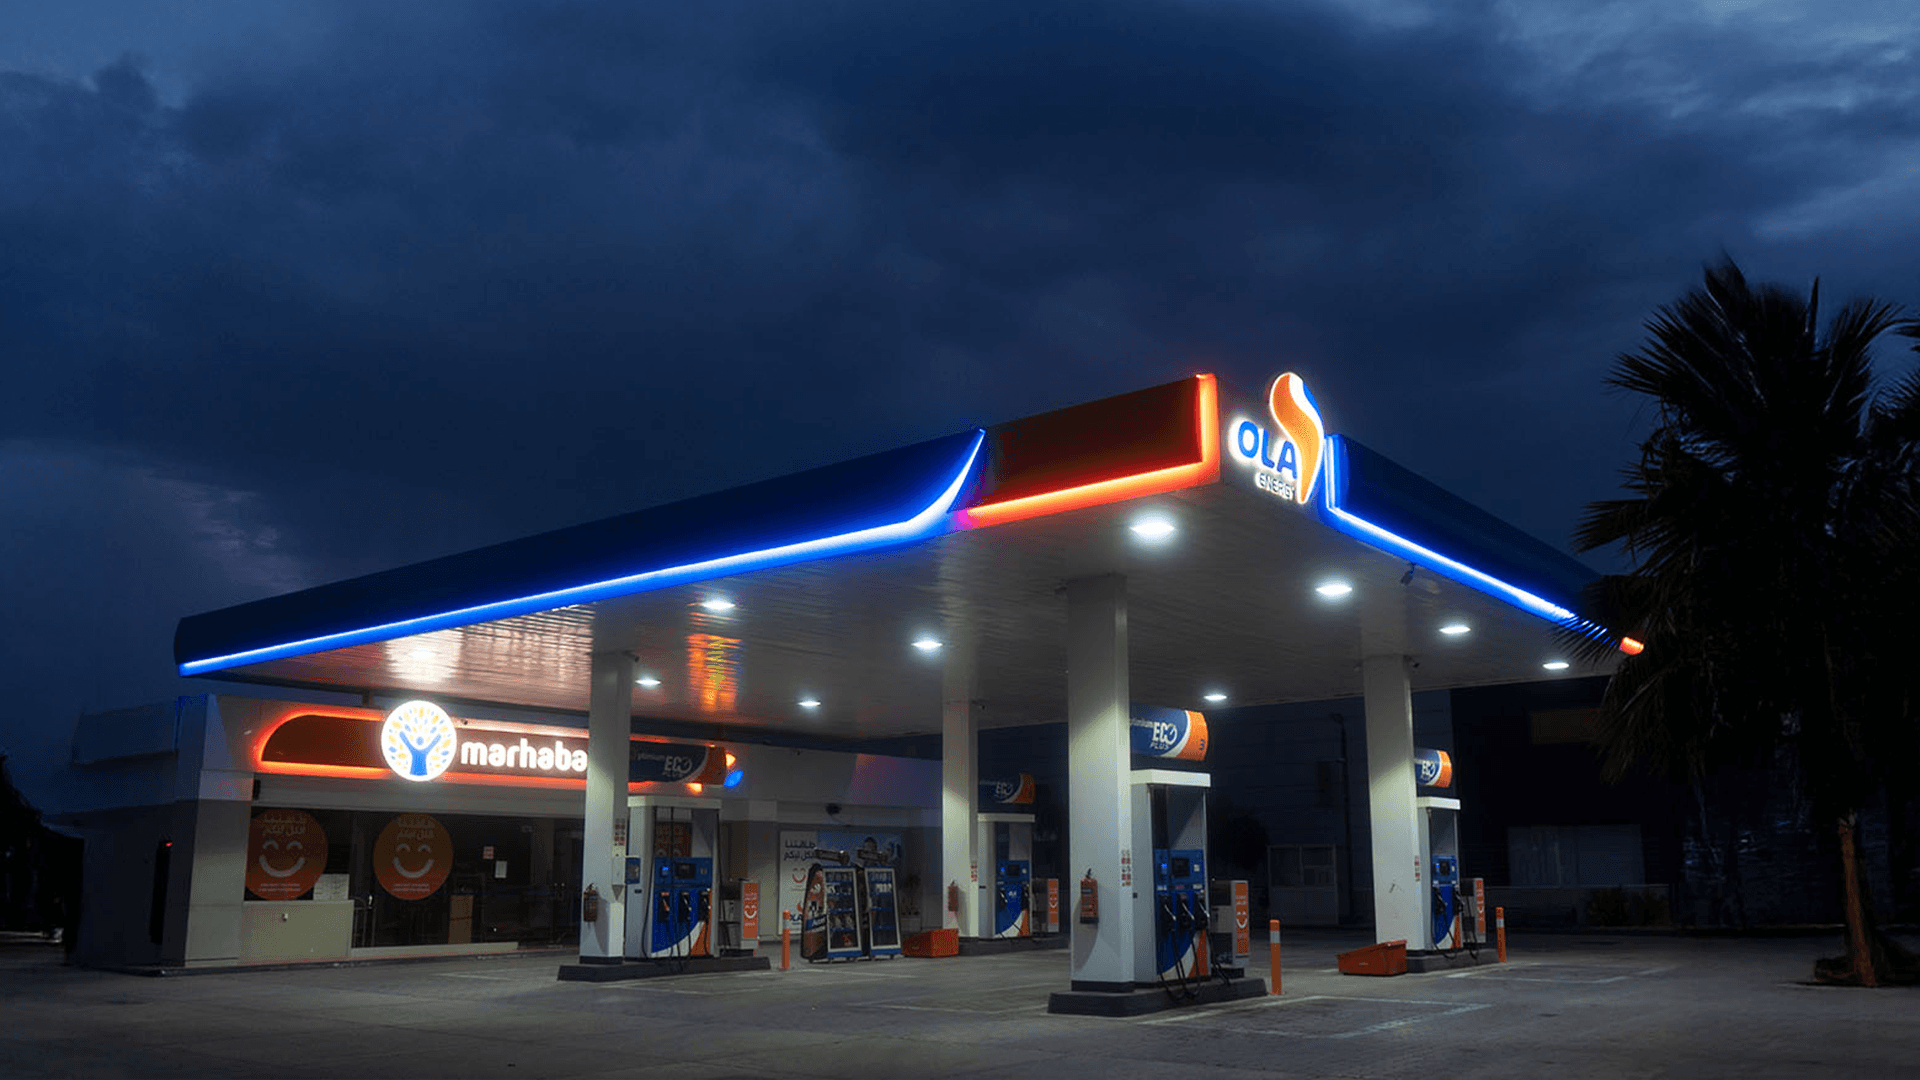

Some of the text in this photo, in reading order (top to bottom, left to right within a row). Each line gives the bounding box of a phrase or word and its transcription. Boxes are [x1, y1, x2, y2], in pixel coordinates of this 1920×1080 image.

[1237, 421, 1298, 480] OLA
[1152, 721, 1178, 746] ECO
[1199, 738, 1206, 751] 3
[460, 737, 588, 773] marhaba
[664, 755, 693, 774] ECO
